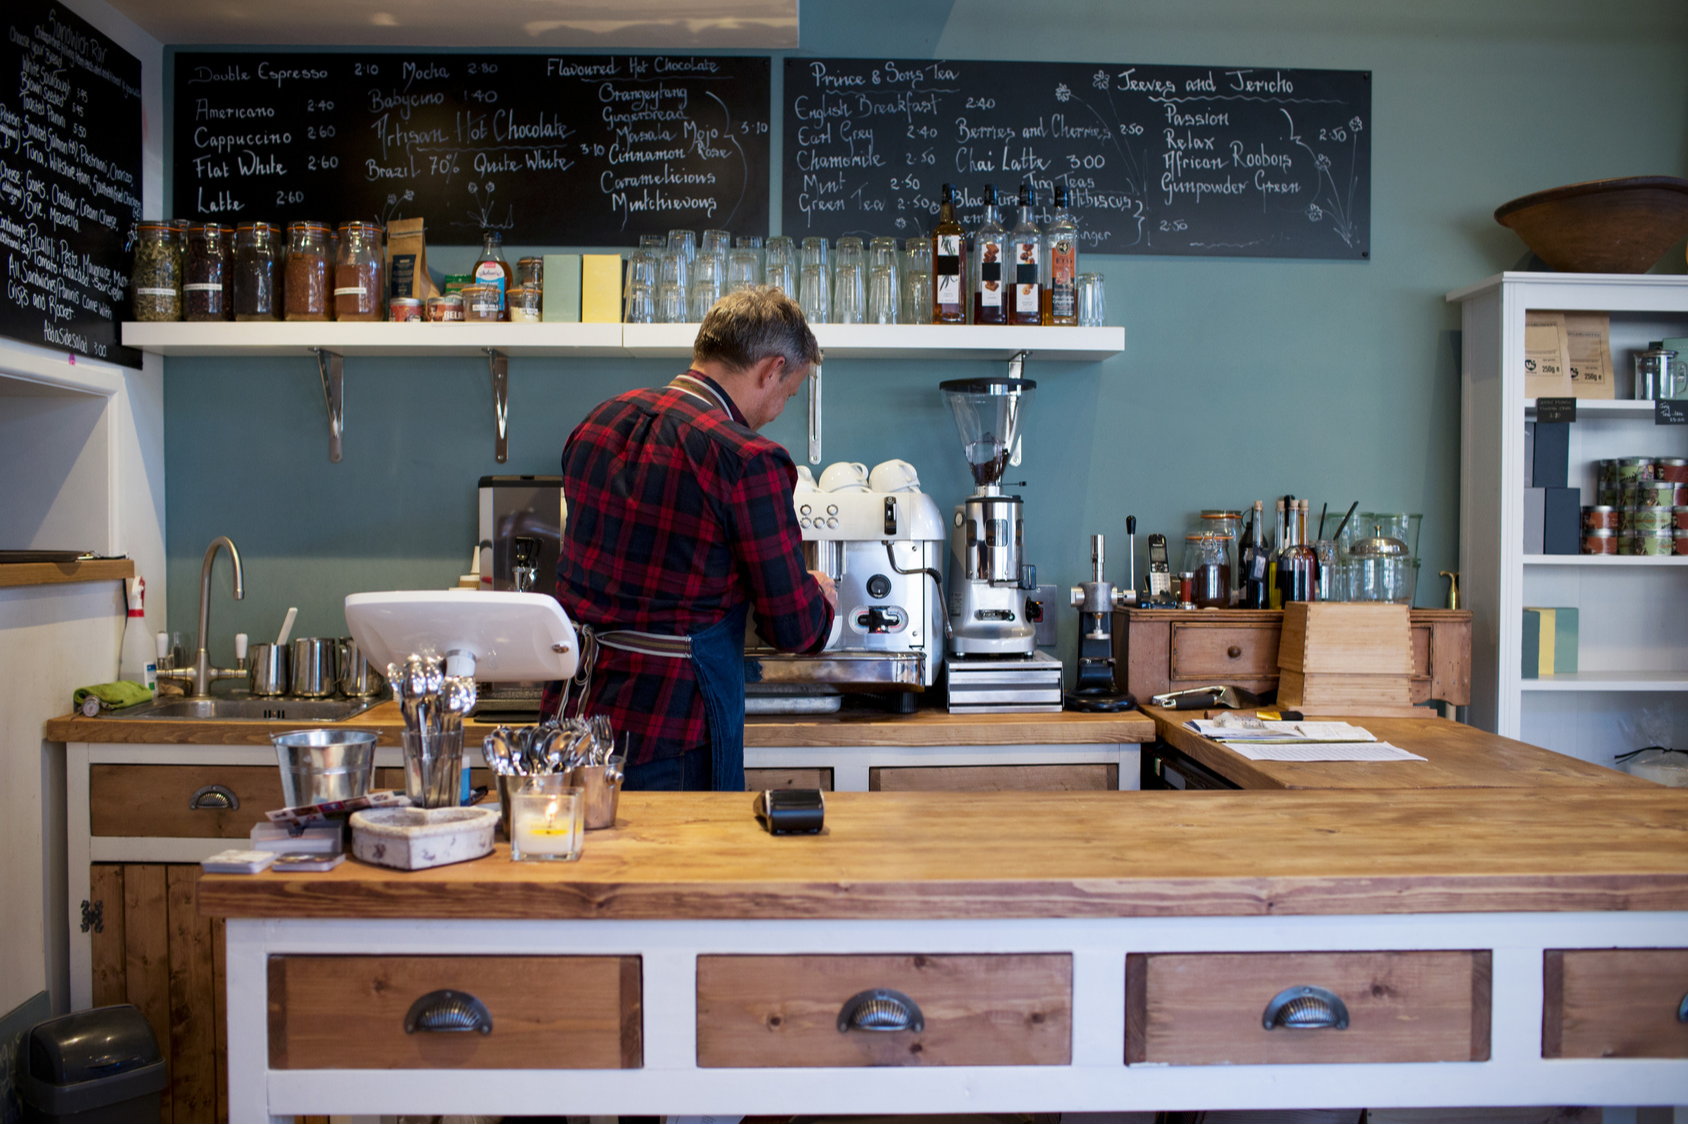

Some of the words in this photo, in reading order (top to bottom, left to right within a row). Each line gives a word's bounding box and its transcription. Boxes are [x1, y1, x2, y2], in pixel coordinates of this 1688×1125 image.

[189, 65, 250, 84] Double
[257, 61, 328, 88] Espresso
[354, 63, 379, 76] 2.10
[402, 61, 450, 94] Mocha
[467, 62, 498, 75] 2.80
[547, 56, 622, 78] Flavoured
[629, 56, 649, 79] Hot
[654, 56, 720, 74] Chocolate
[809, 61, 866, 88] Prince
[871, 69, 882, 84] &
[925, 60, 960, 82] Tea
[599, 81, 688, 111] Orangeytang
[1117, 67, 1176, 98] Jeeves
[1186, 70, 1217, 93] and
[1225, 69, 1294, 94] Jericho
[195, 98, 275, 121] Americano
[307, 100, 335, 111] 2.40
[367, 88, 444, 121] Babycino
[602, 105, 690, 131] Gingerbread
[794, 94, 853, 129] English
[855, 91, 942, 124] Breakfast
[965, 97, 996, 110] 2.40
[371, 113, 449, 161] Artisan
[456, 109, 488, 145] Hot
[493, 107, 576, 143] Chocolate
[616, 123, 677, 154] Masala
[683, 120, 718, 154] Mojo
[955, 117, 1016, 144] Berries
[1022, 116, 1050, 138] and
[1119, 123, 1144, 136] 2.50
[1163, 103, 1229, 127] Passion
[1319, 126, 1348, 142] 2.50
[193, 126, 292, 154] Cappuccino
[307, 125, 336, 139] 2.60
[608, 143, 686, 165] Cinnamon
[697, 140, 732, 160] Rose
[798, 122, 831, 146] Earl
[839, 119, 874, 160] Grey
[906, 125, 938, 138] 2.40
[1163, 128, 1215, 151] Relax
[192, 154, 230, 179] Flat
[238, 149, 287, 177] White
[308, 156, 339, 170] 2.60
[365, 155, 420, 182] Brazil
[429, 151, 460, 184] 70%
[473, 152, 523, 179] Quite
[525, 150, 574, 172] White
[580, 143, 605, 158] 3.10
[796, 144, 886, 171] Chamomile
[906, 147, 936, 166] 2.50
[955, 147, 995, 173] Chai
[1002, 142, 1052, 172] Latte
[1066, 154, 1105, 169] 3.00
[1163, 150, 1229, 182] African
[803, 171, 846, 200] Mint
[890, 173, 920, 190] 2.50
[1055, 171, 1095, 189] Teas
[1161, 170, 1249, 205] Gunpowder
[1254, 169, 1302, 214] Green
[197, 186, 245, 214] Latte
[276, 190, 304, 205] 2.60
[798, 192, 846, 228] Green
[850, 181, 886, 212] Tea
[1068, 187, 1132, 212] Hibiscus
[1160, 218, 1188, 232] 2.50
[1542, 365, 1555, 375] 250g
[1584, 373, 1597, 382] 250g
